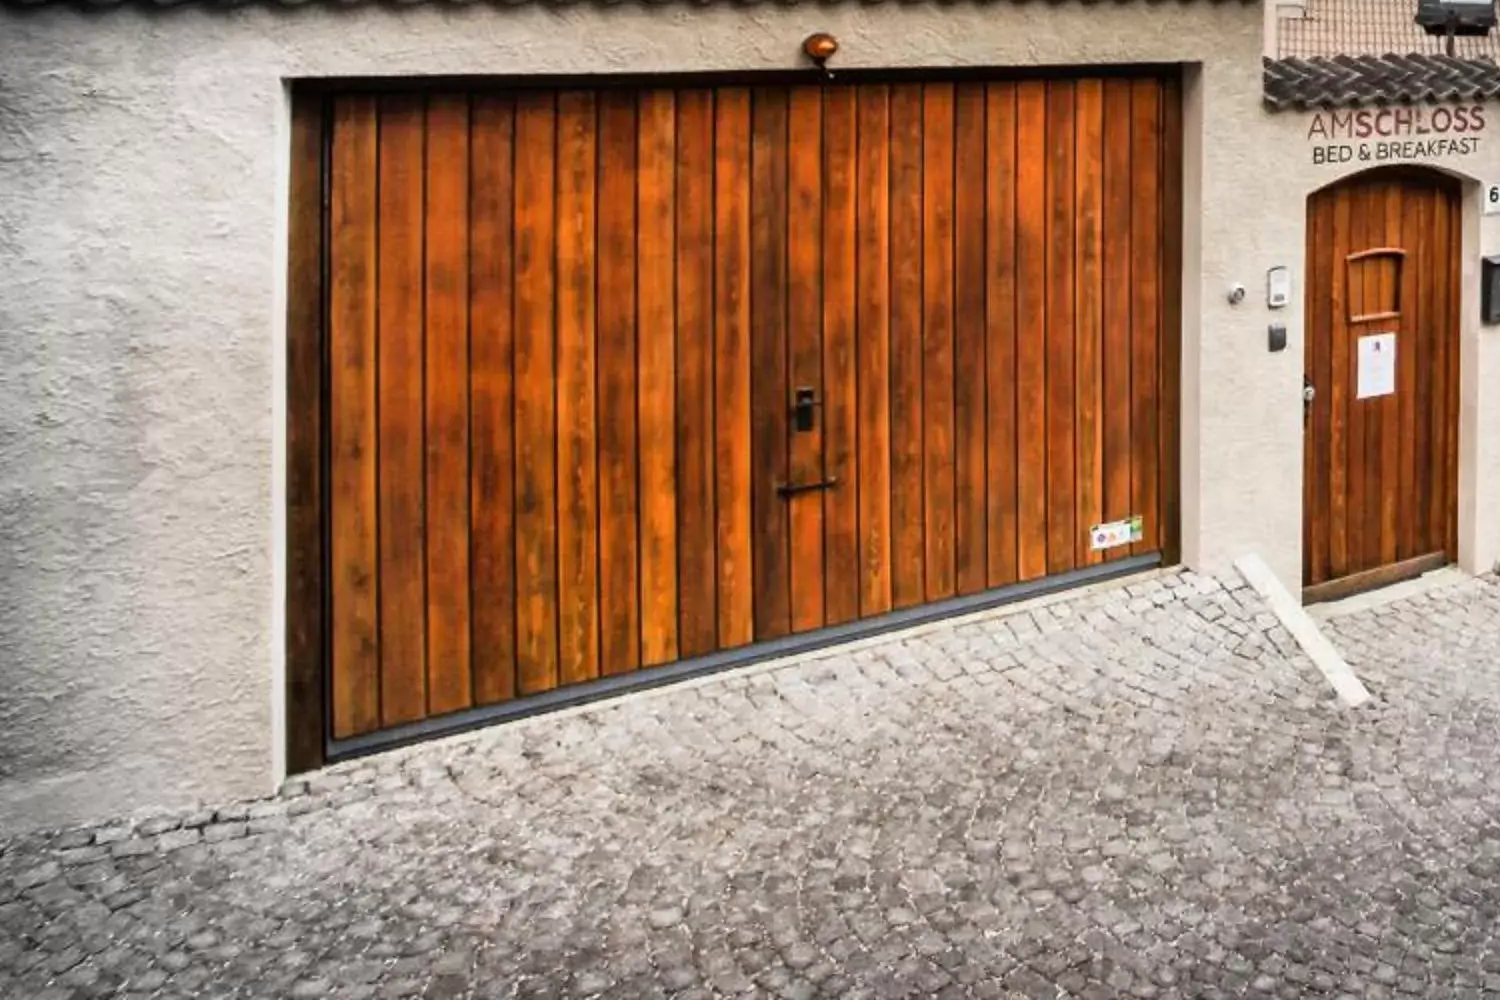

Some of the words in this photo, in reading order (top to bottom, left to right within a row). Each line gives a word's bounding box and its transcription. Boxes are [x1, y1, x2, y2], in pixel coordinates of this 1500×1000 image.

[1312, 144, 1352, 164] BED
[1358, 143, 1371, 161] &
[1375, 137, 1481, 160] BREAKFAST
